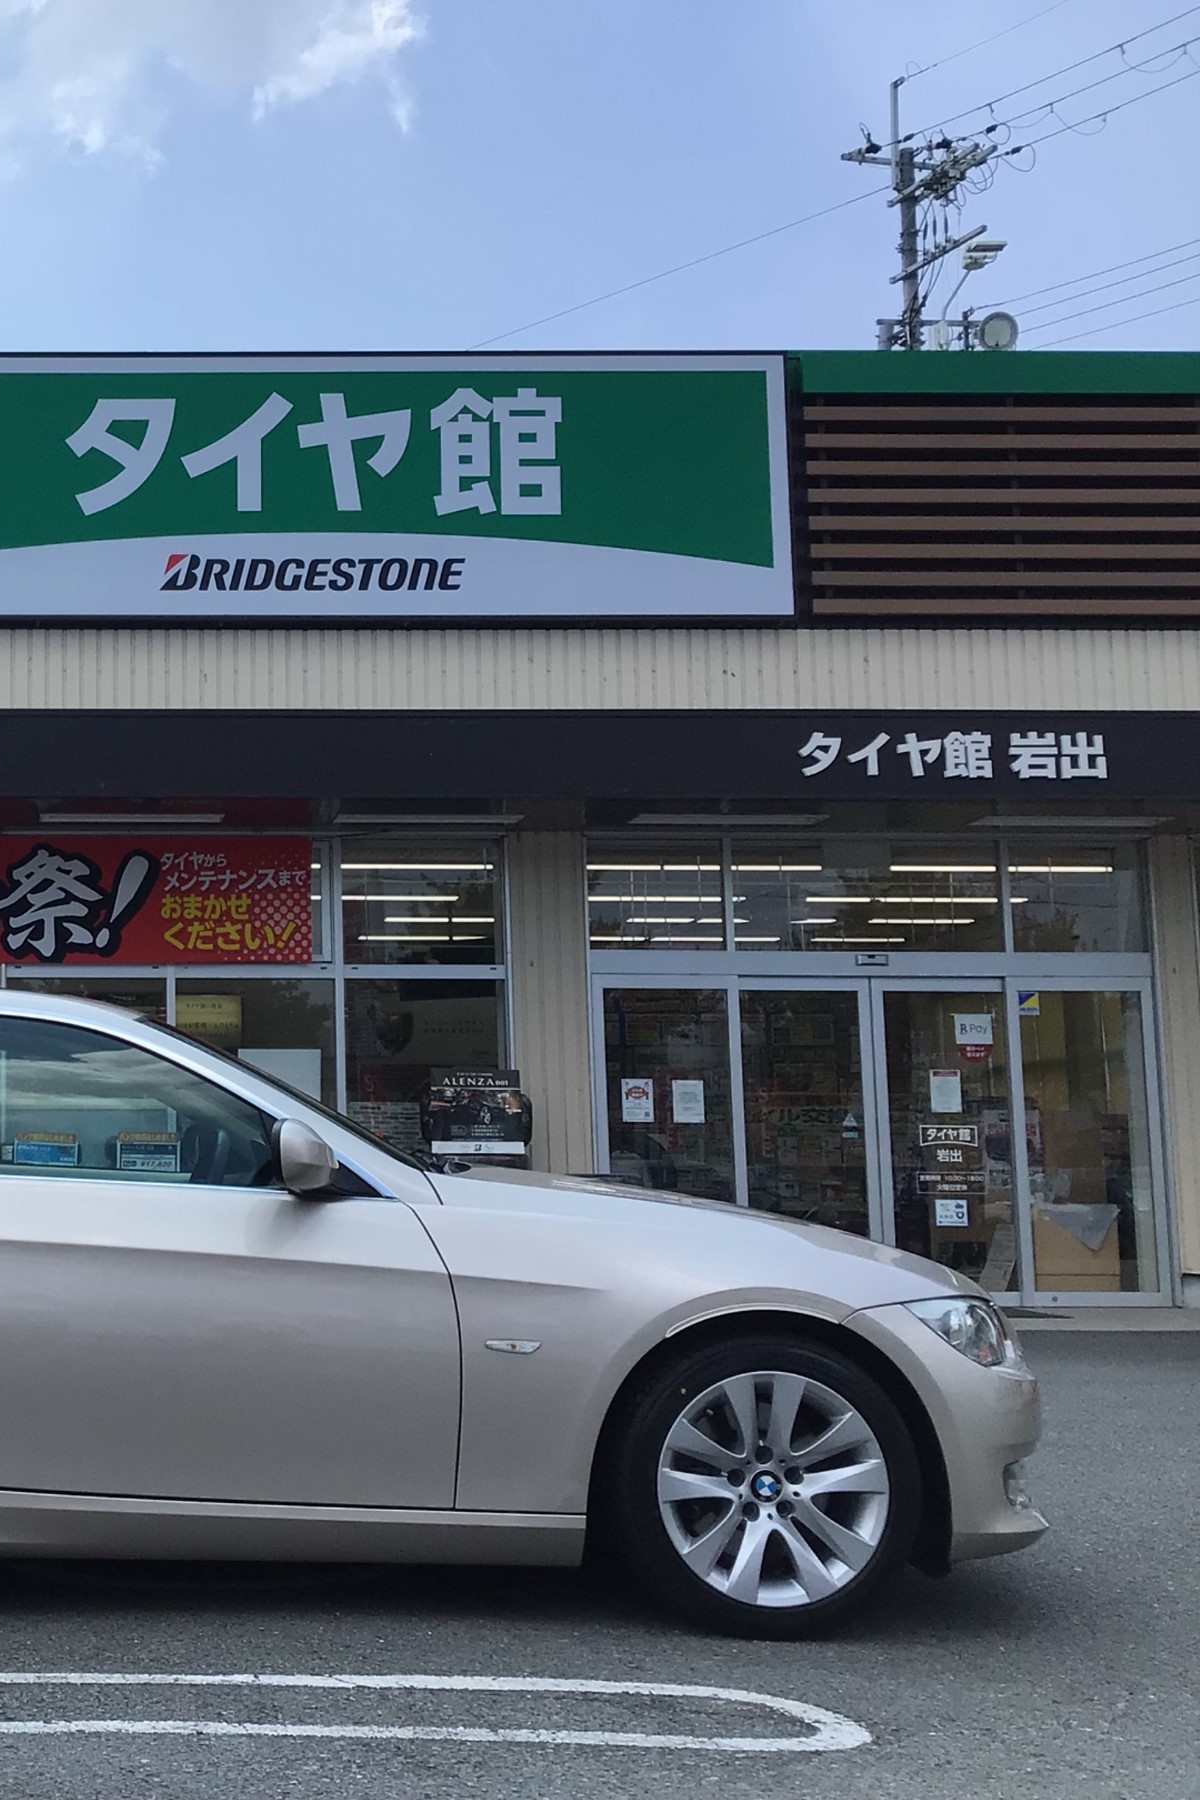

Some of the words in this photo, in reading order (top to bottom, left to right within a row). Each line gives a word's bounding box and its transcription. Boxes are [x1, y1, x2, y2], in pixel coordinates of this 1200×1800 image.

[64, 386, 563, 517] タイヤ館
[158, 553, 466, 592] BRIDGESTONE
[798, 731, 993, 779] タイヤ館
[1008, 731, 1108, 779] 岩出
[160, 851, 227, 871] タイヤから
[163, 868, 306, 892] メンテナンスまで
[160, 893, 251, 920] おまかせ
[163, 920, 297, 951] ください!
[969, 1023, 989, 1035] Pay
[926, 1128, 971, 1141] タイヤ館
[936, 1148, 963, 1162] 岩出
